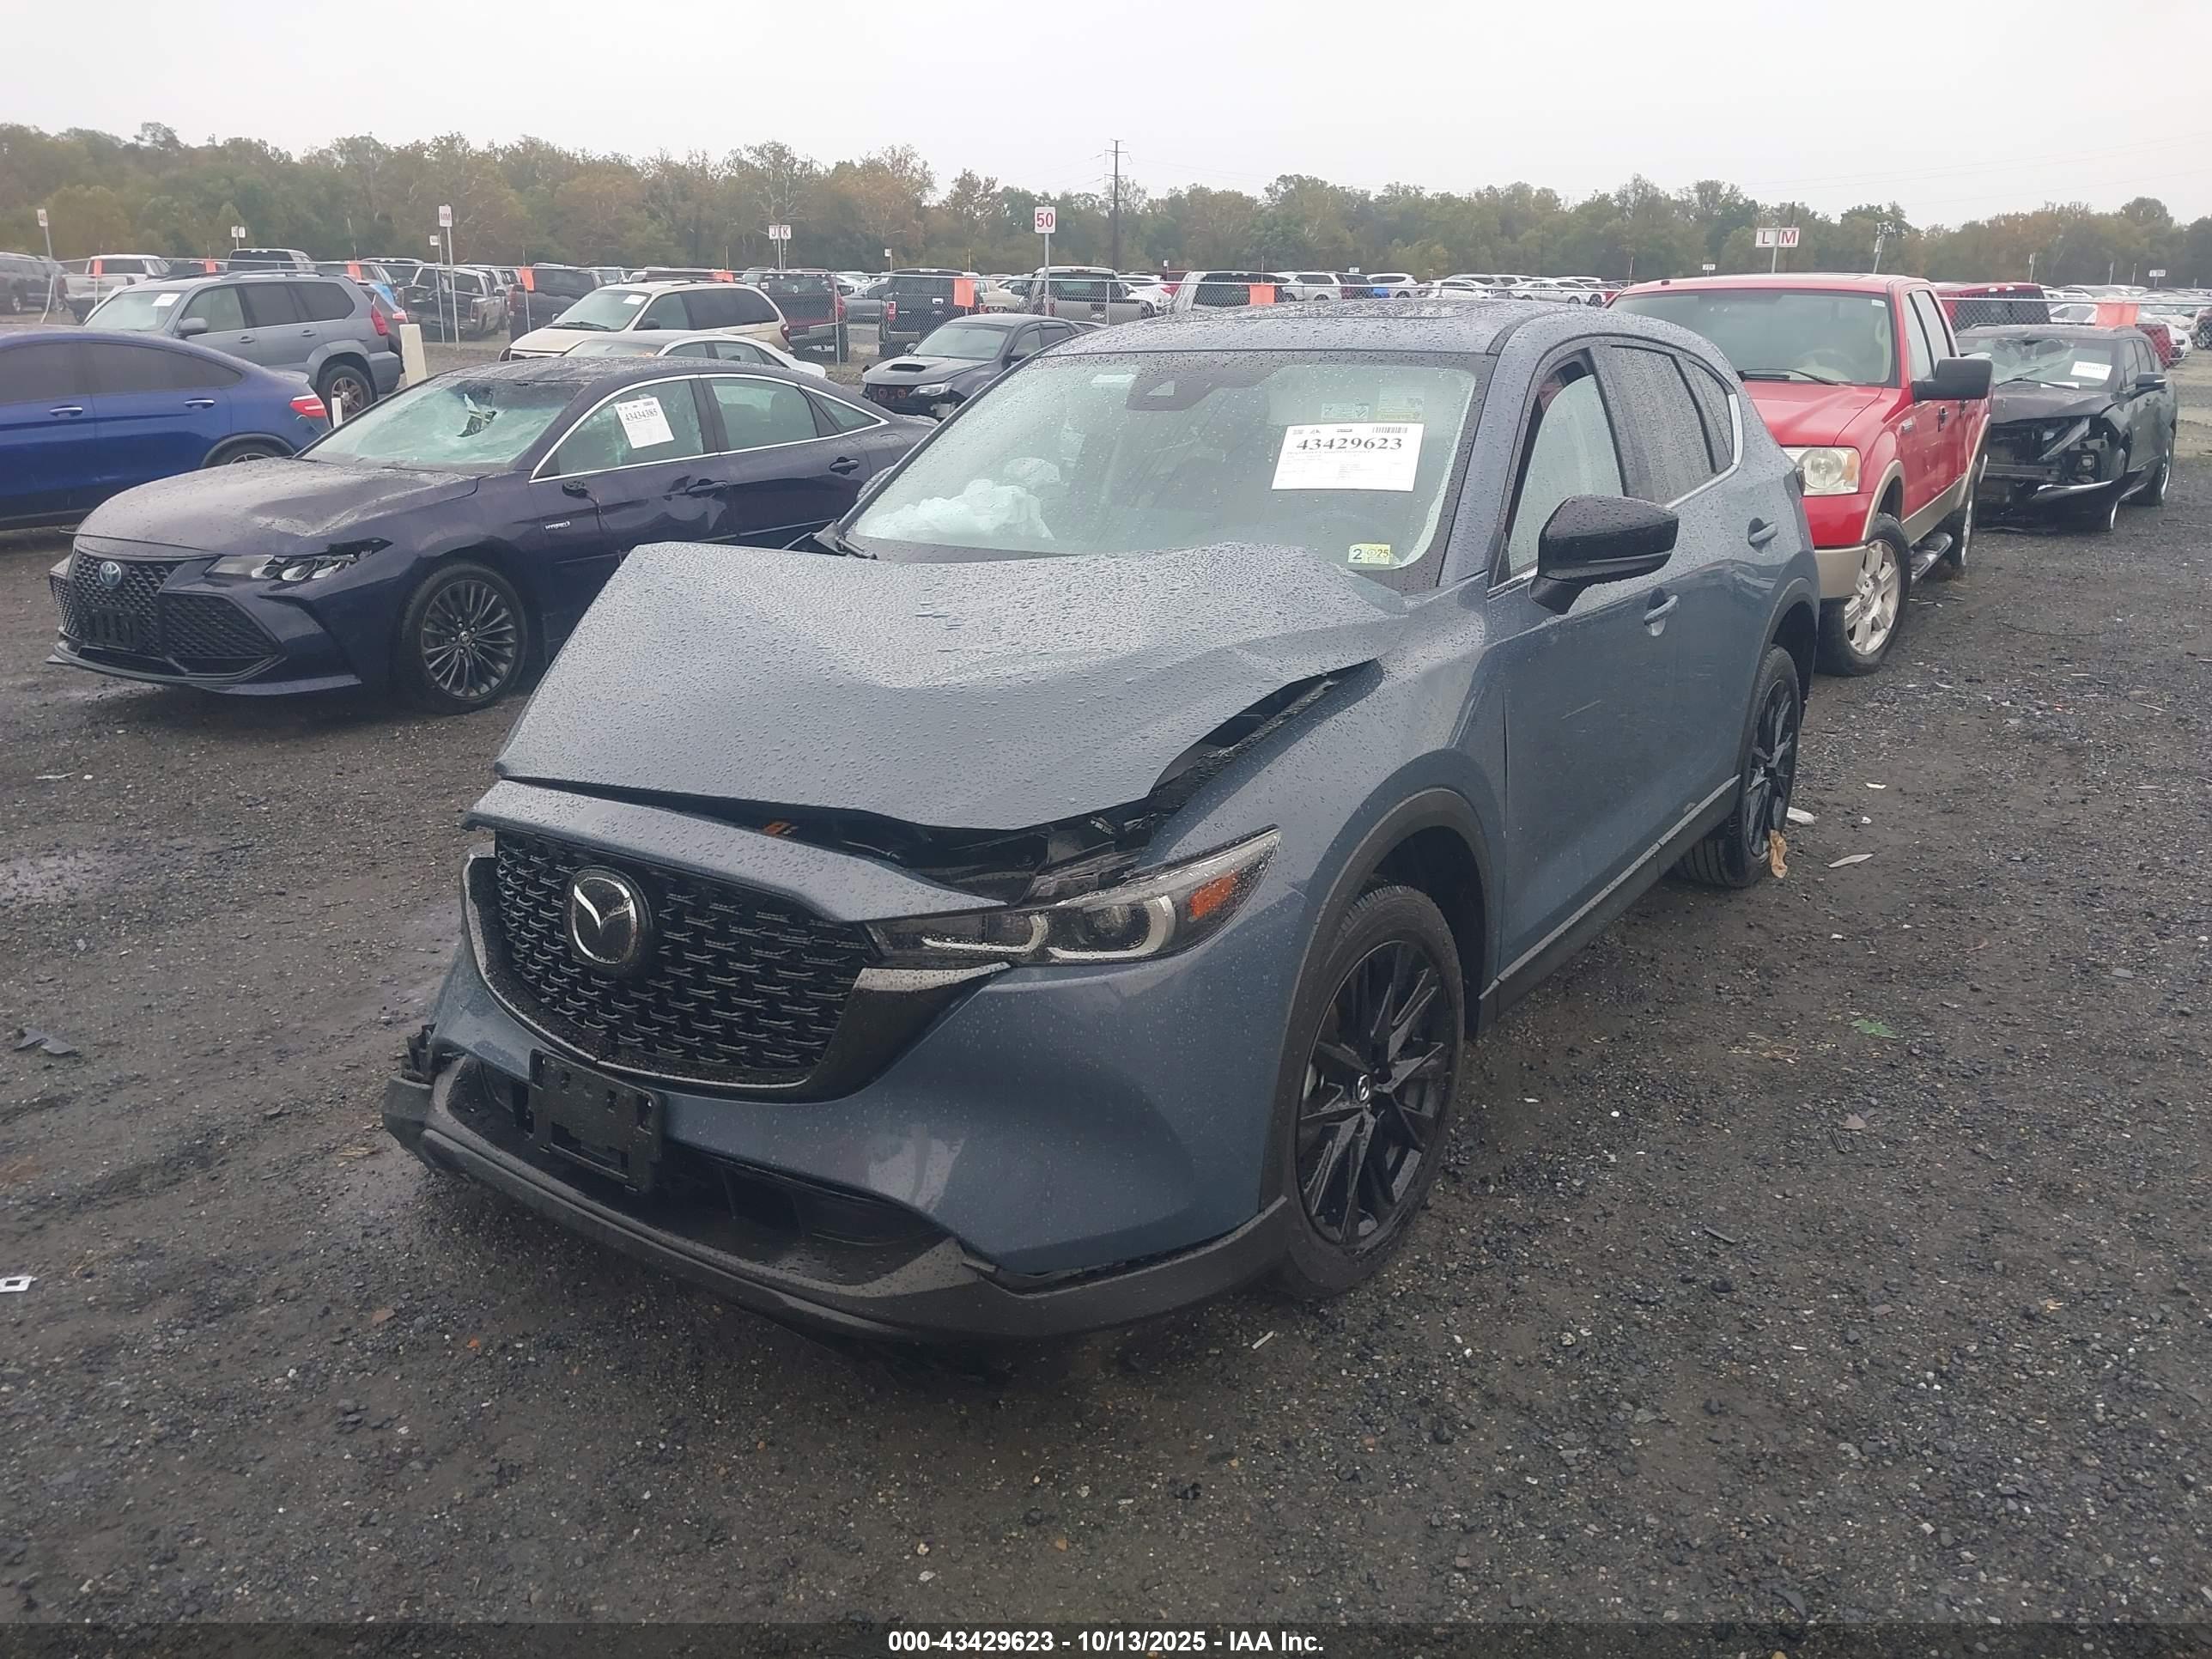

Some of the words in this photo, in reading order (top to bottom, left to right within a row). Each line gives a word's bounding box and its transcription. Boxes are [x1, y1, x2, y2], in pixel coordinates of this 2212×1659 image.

[1036, 212, 1054, 228] 50
[771, 227, 776, 237] J
[782, 227, 789, 237] K
[1762, 231, 1771, 244] L
[1781, 231, 1796, 244] M
[1296, 438, 1402, 451] 43429623
[1352, 548, 1362, 560] 2
